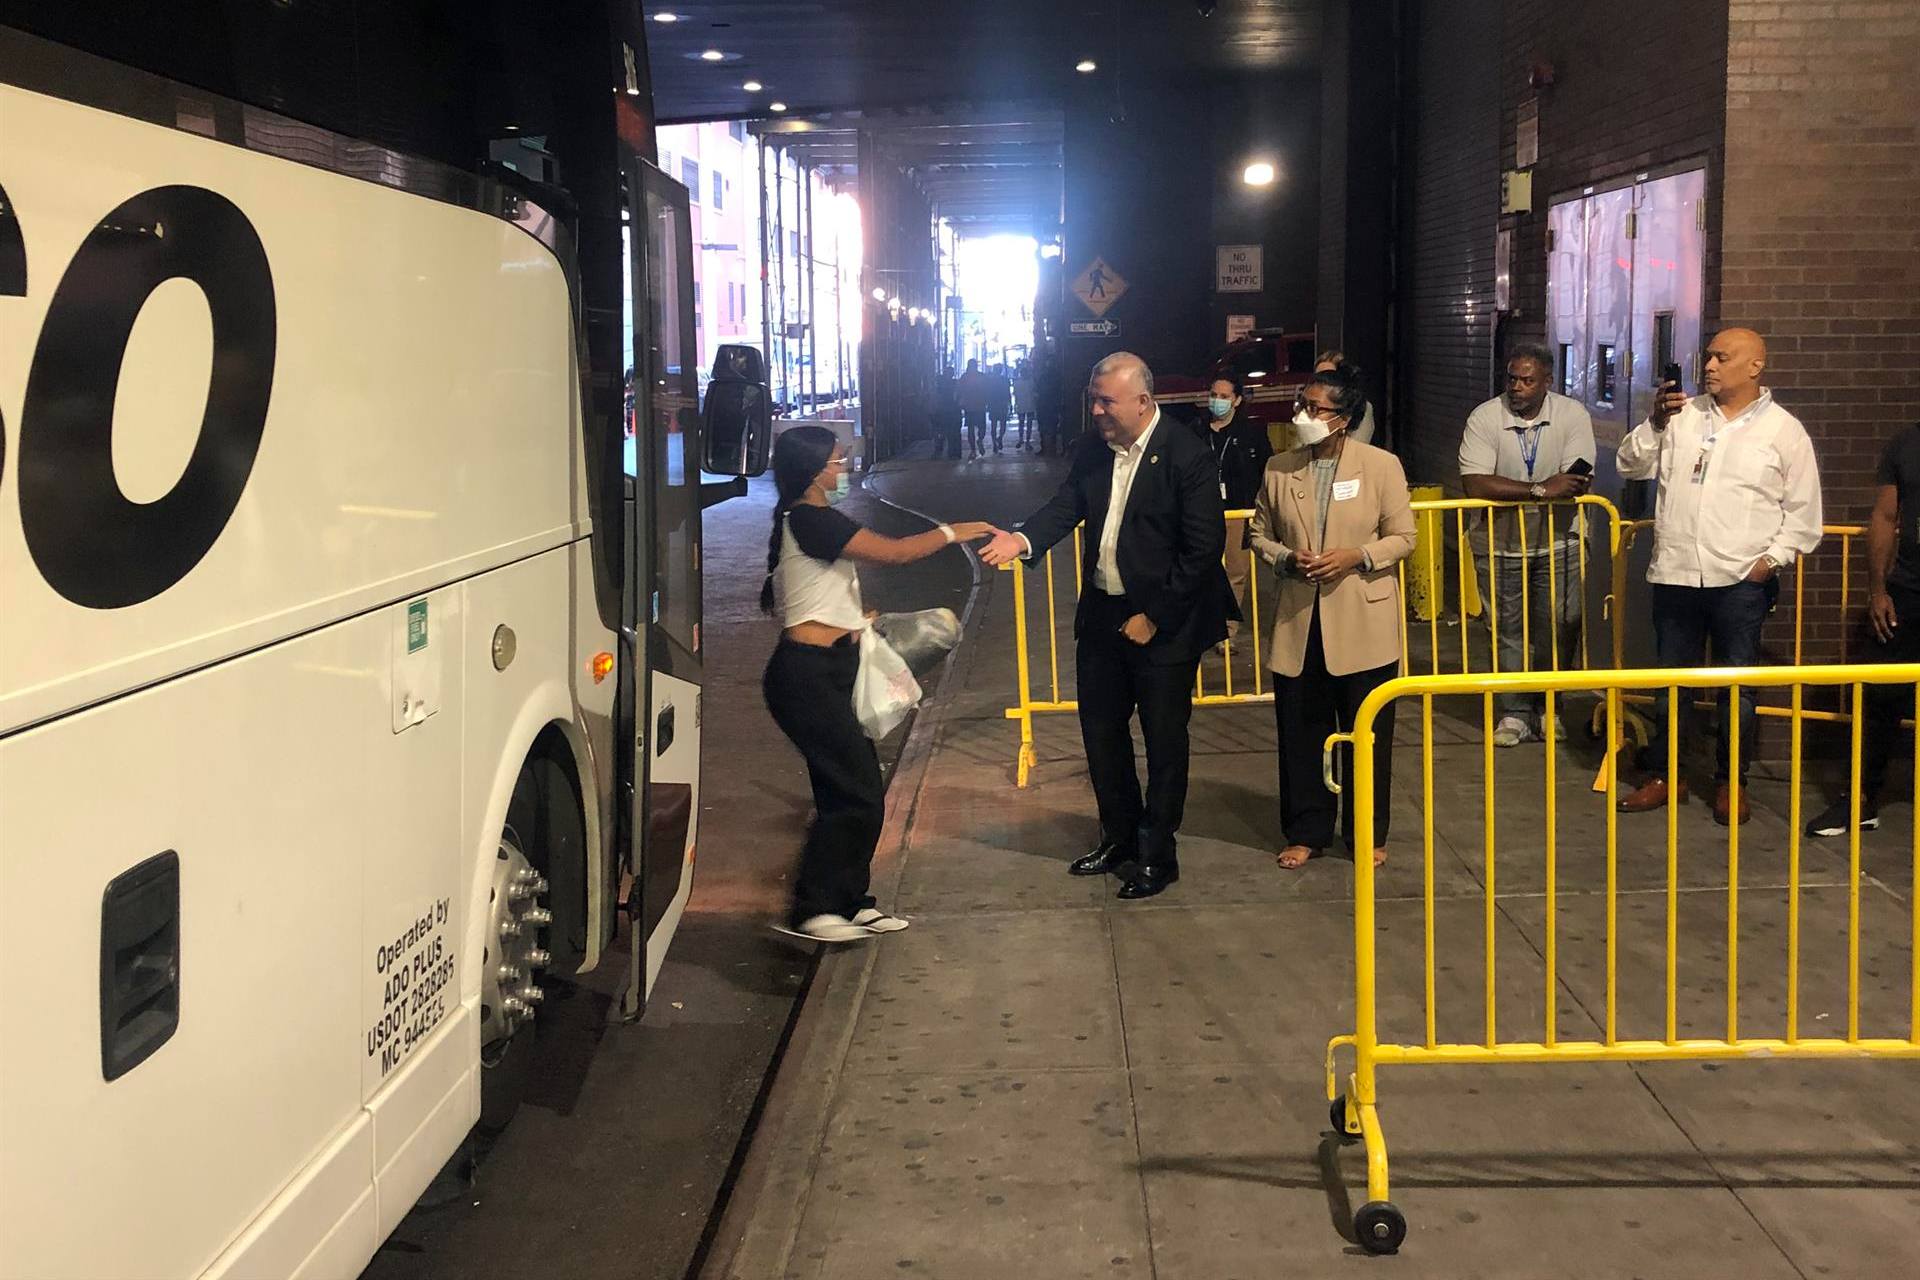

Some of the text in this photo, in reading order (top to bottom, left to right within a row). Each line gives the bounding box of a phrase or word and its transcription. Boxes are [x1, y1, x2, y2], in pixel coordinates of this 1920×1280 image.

[1221, 275, 1258, 286] TRAFFIC
[1228, 264, 1252, 274] THRU
[1233, 252, 1246, 262] NO
[0, 184, 277, 609] O
[376, 896, 450, 975] Operated by
[383, 934, 442, 1010] ADO PLUS
[367, 953, 454, 1058] USDOT 2828285
[381, 1036, 401, 1078] MC
